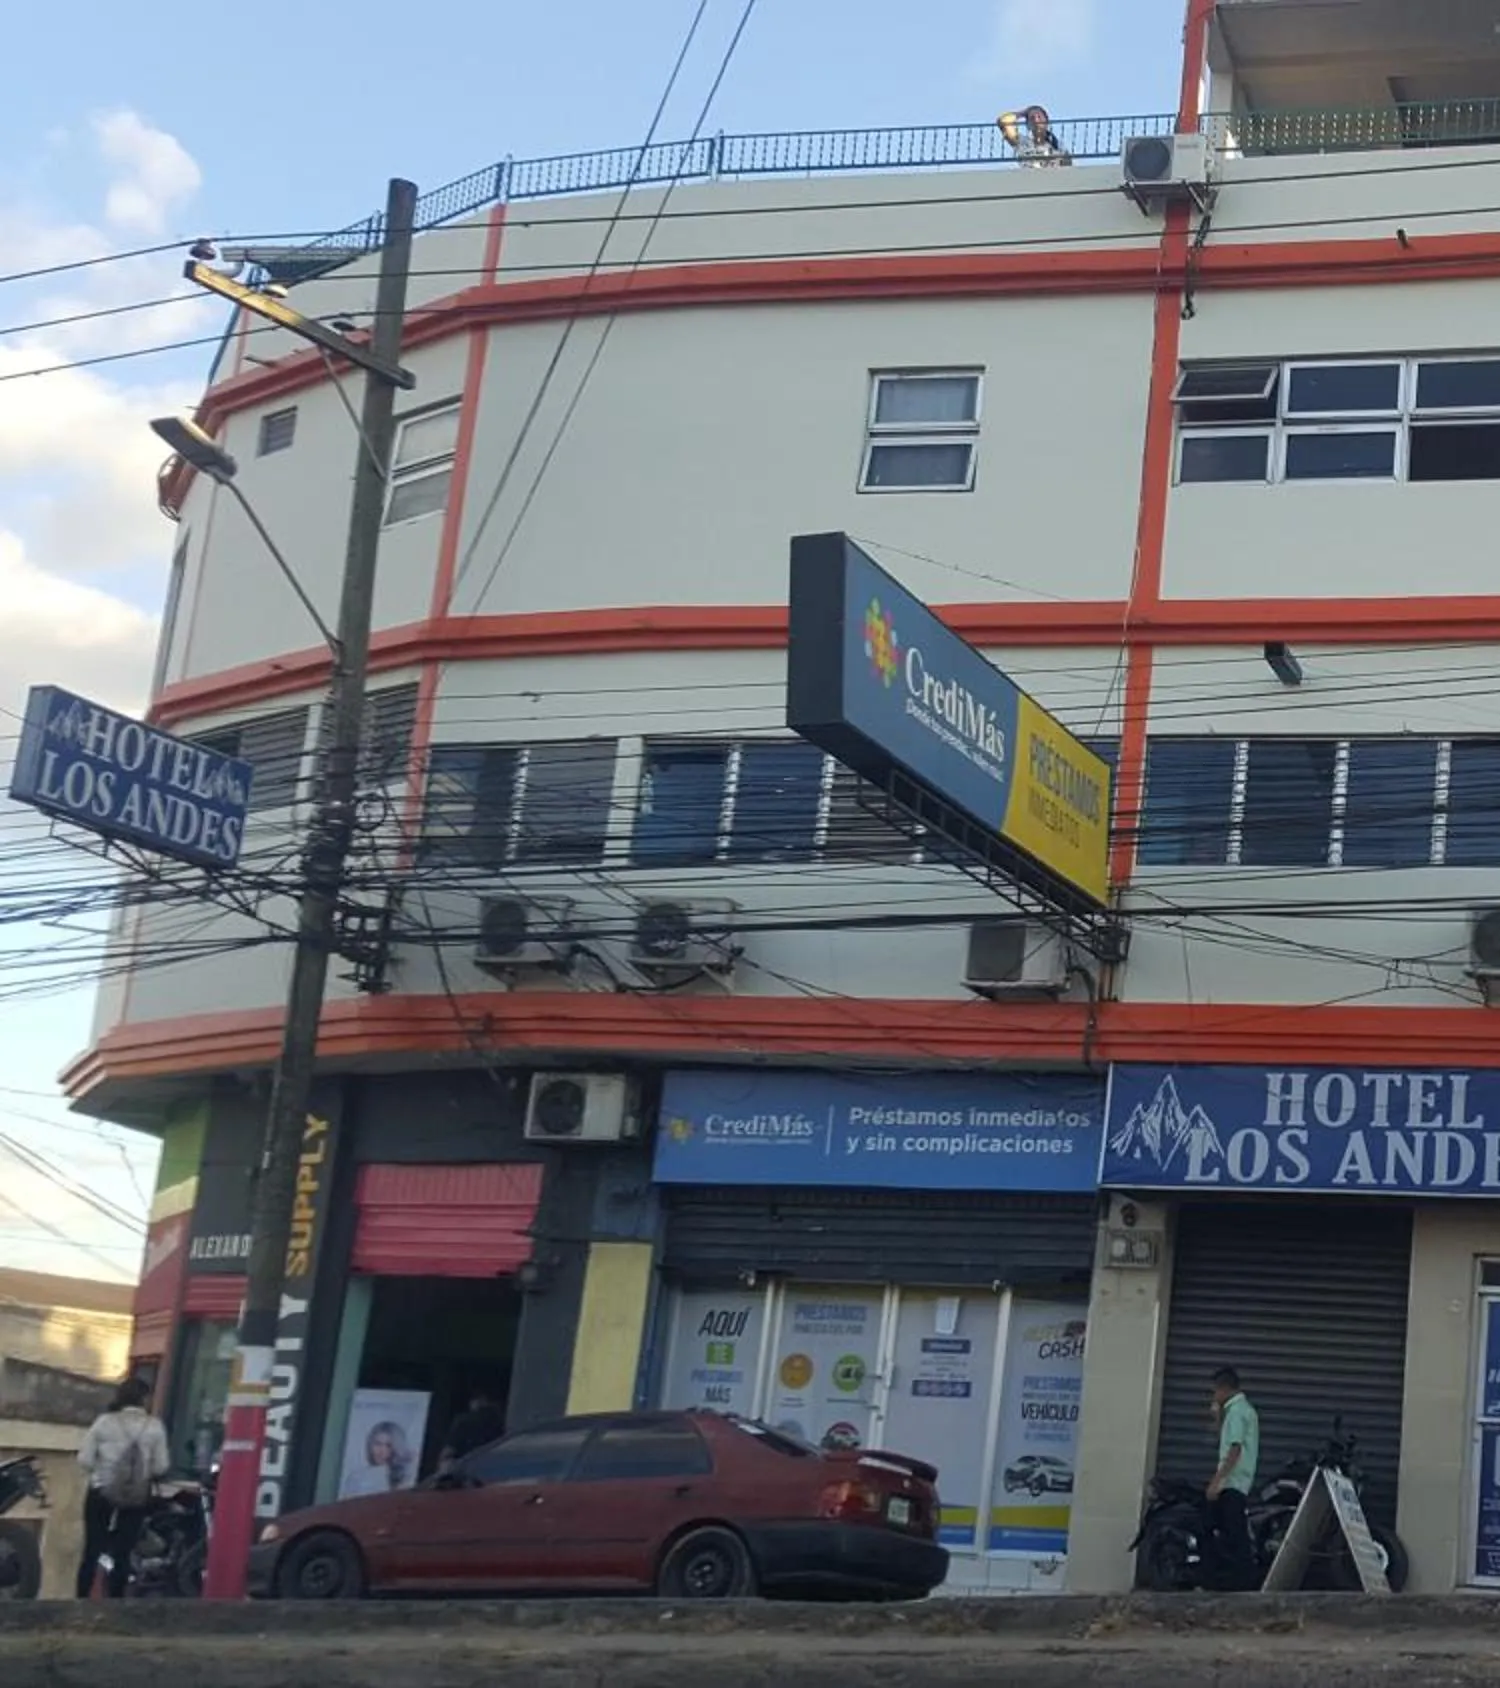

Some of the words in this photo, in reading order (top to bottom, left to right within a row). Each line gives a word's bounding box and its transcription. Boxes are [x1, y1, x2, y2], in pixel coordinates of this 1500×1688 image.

[906, 647, 1005, 763] CrediMás
[81, 708, 213, 800] HOTEL
[37, 750, 116, 817] LOS
[117, 783, 241, 861] ANDES
[705, 1113, 815, 1136] CrediMás
[849, 1107, 962, 1127] Préstamos
[969, 1107, 1091, 1128] inmediatos
[1262, 1072, 1484, 1130] HOTEL
[847, 1135, 860, 1154] y
[865, 1133, 896, 1151] sin
[902, 1133, 1073, 1155] complicaciones
[1183, 1127, 1310, 1184] LOS
[284, 1113, 331, 1278] SUPPLY
[698, 1306, 752, 1337] AQUÍ
